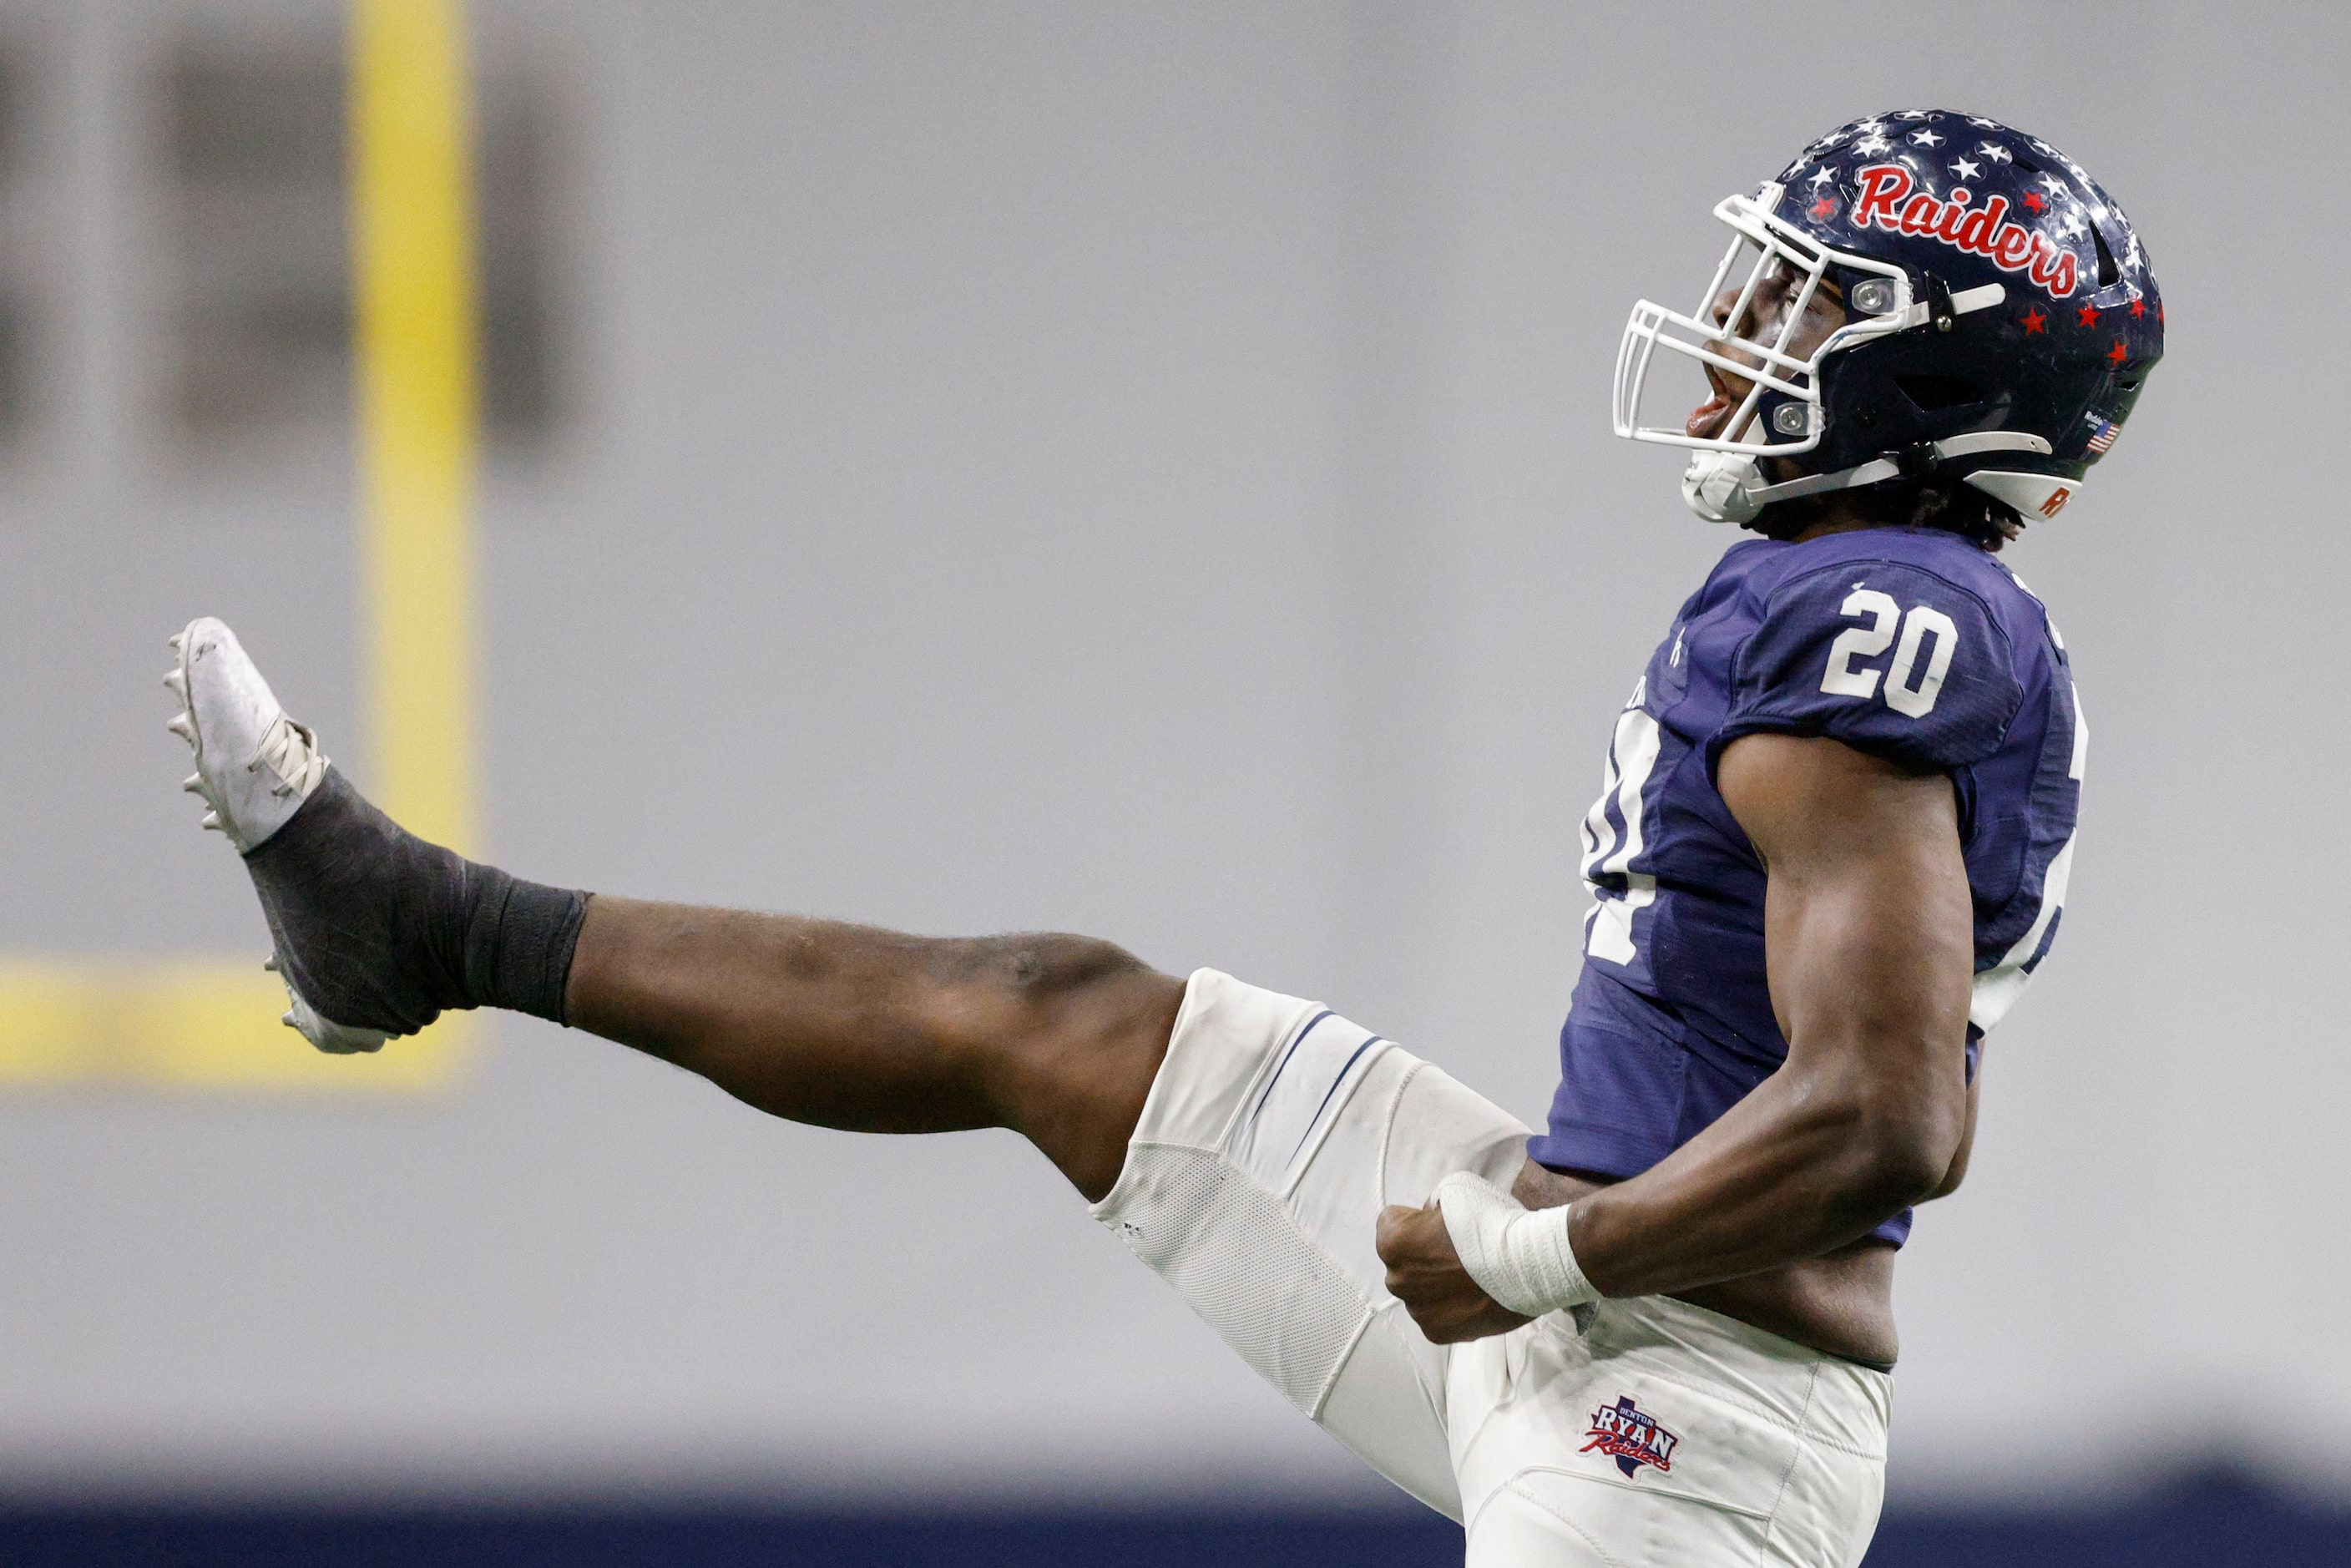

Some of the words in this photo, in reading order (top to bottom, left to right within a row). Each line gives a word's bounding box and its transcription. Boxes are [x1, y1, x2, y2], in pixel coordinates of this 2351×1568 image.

[1851, 164, 2078, 299] Raiders
[1819, 589, 1959, 720] 20
[1595, 1408, 1674, 1460] RYAN
[1620, 1407, 1654, 1427] DENTON
[1579, 1429, 1671, 1472] Raiders
